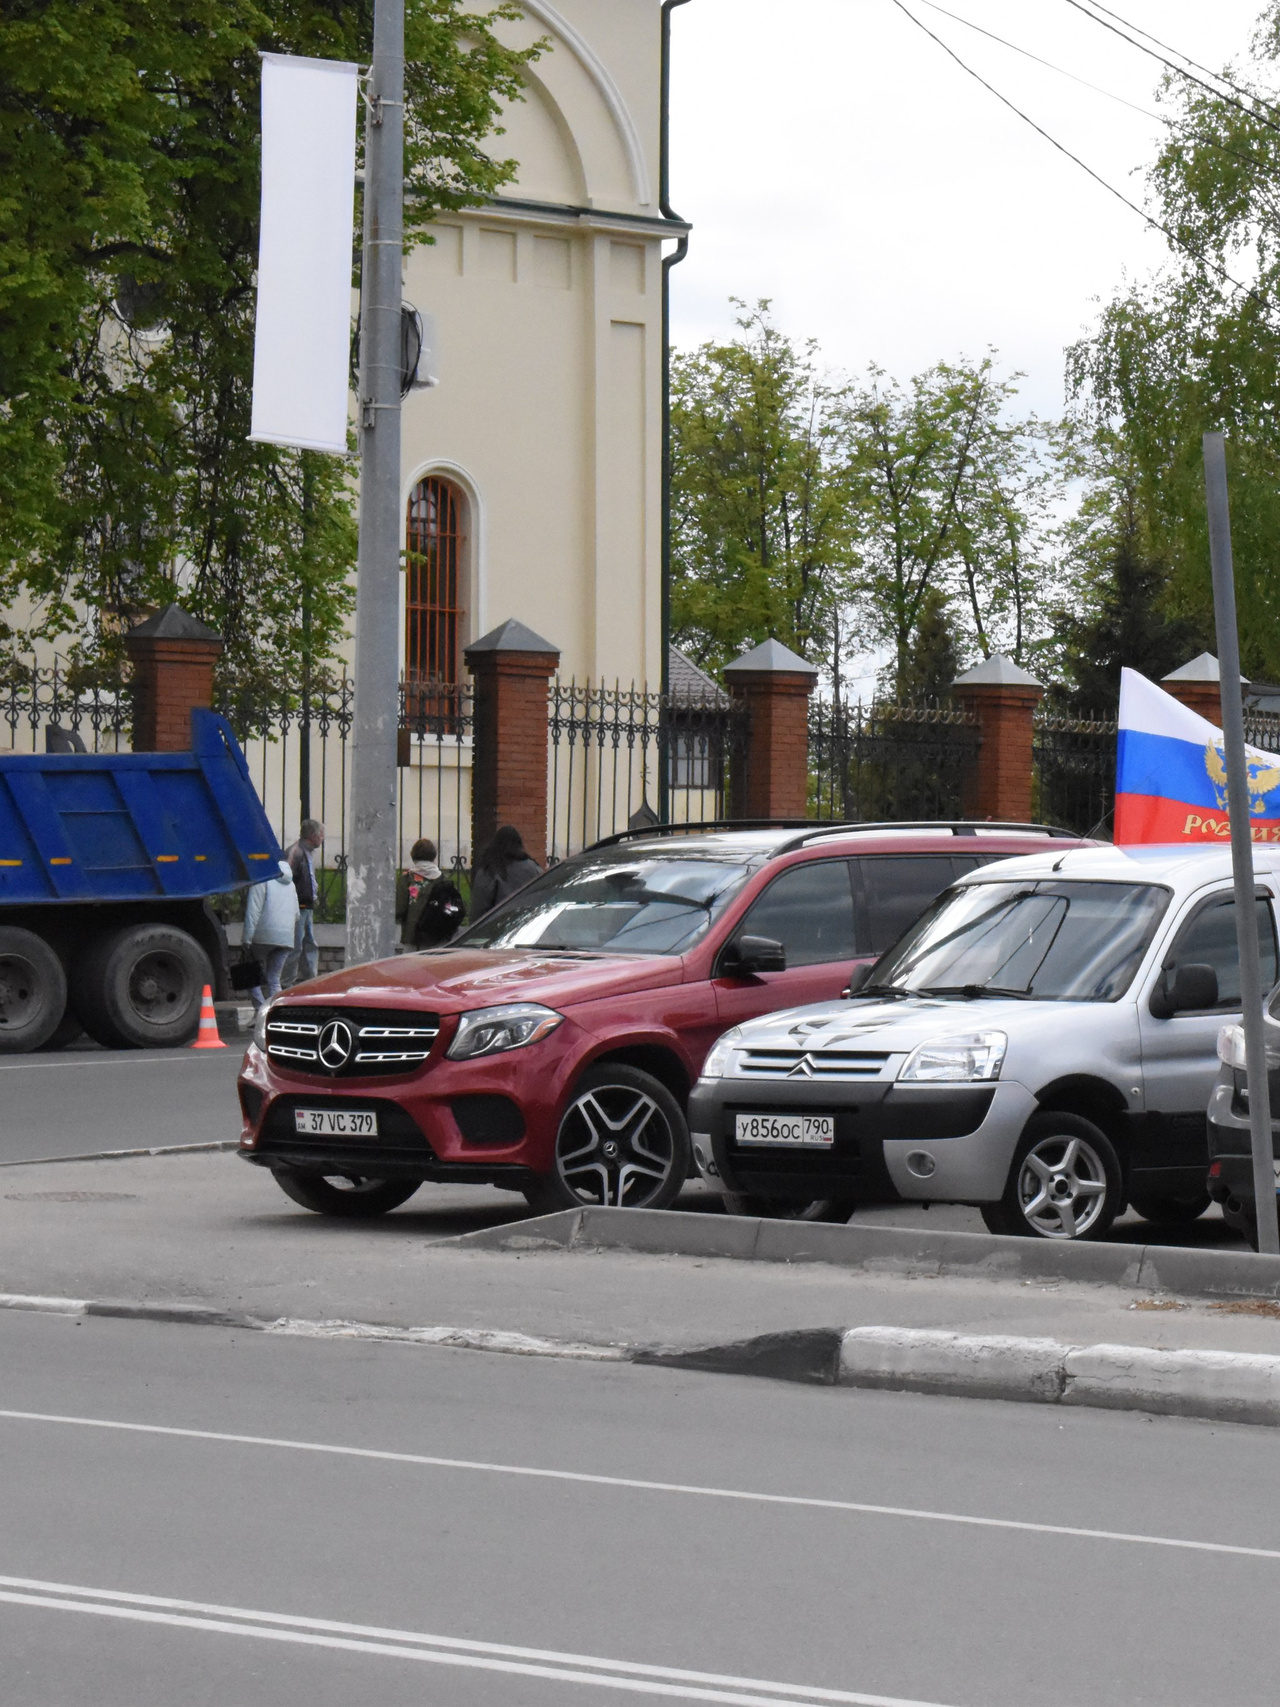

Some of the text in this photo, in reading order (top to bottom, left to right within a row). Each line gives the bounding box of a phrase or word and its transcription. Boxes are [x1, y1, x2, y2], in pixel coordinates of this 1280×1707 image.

[310, 1112, 373, 1133] 37 VC 379
[803, 1118, 830, 1135] 790
